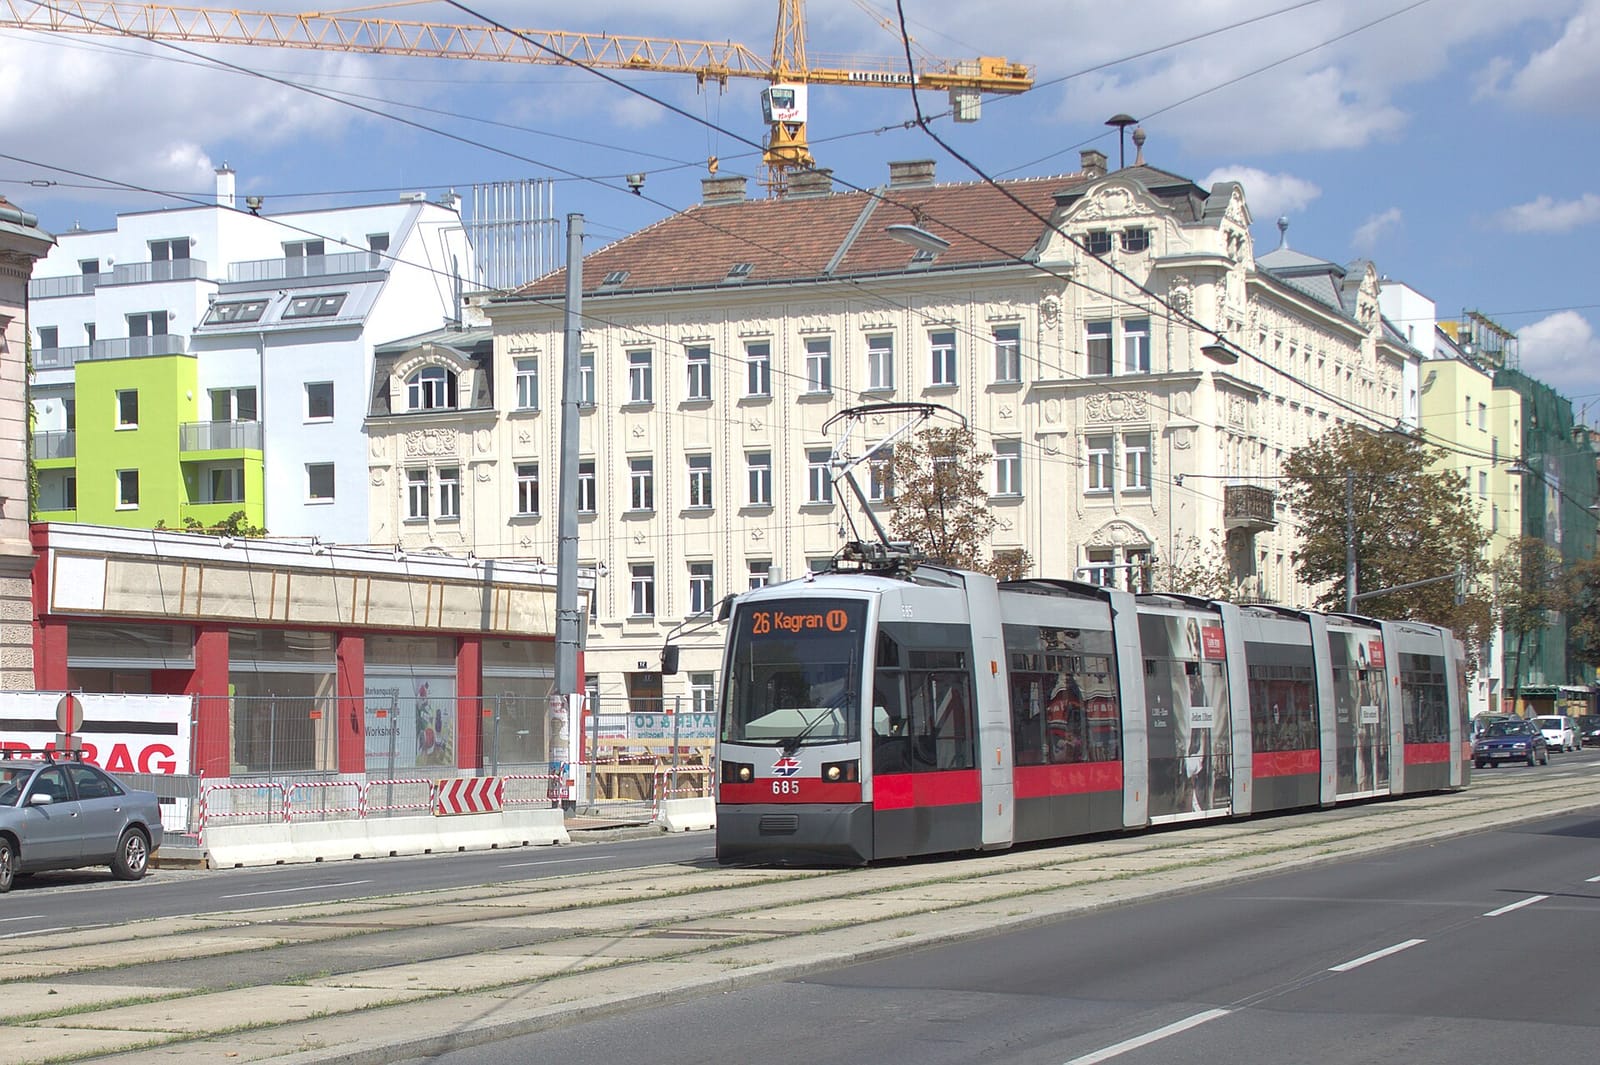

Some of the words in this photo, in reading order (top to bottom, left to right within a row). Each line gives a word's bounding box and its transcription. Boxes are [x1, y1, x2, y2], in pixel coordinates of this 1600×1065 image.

[853, 73, 914, 83] LIEBHERR
[752, 612, 771, 634] 26
[774, 611, 824, 633] Kagran
[772, 781, 800, 794] 685
